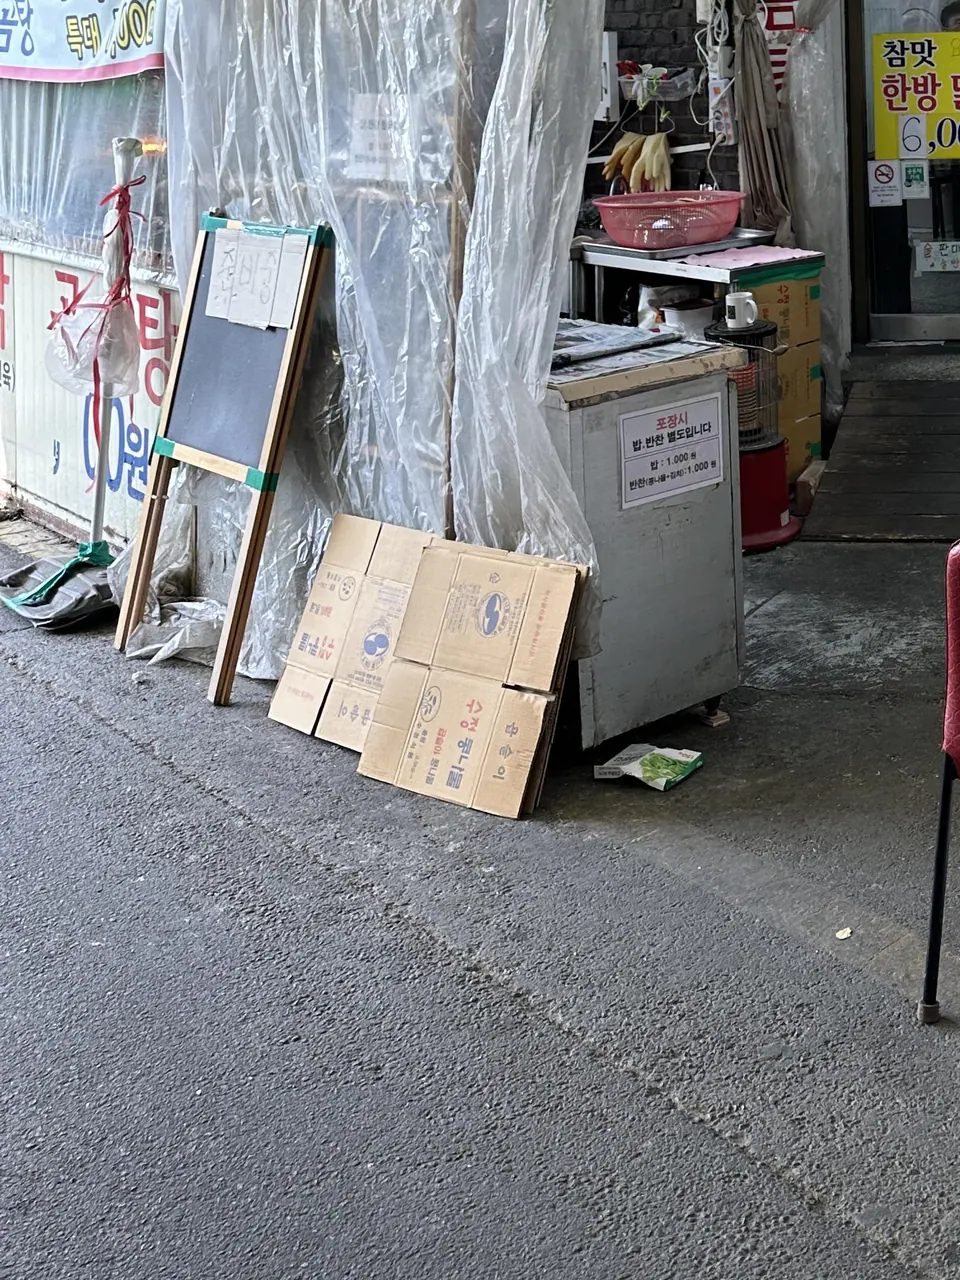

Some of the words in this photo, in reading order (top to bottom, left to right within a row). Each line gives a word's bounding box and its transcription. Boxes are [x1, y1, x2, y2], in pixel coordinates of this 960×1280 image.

[882, 38, 937, 68] 참맛
[881, 72, 942, 112] 한방
[632, 433, 664, 452] 밥.반찬
[667, 421, 712, 443] 별도입니다
[656, 411, 688, 431] 포장시
[650, 460, 659, 471] 밥
[667, 452, 689, 466] 1.000
[460, 698, 484, 732] 수정
[446, 737, 474, 790] 콩나물
